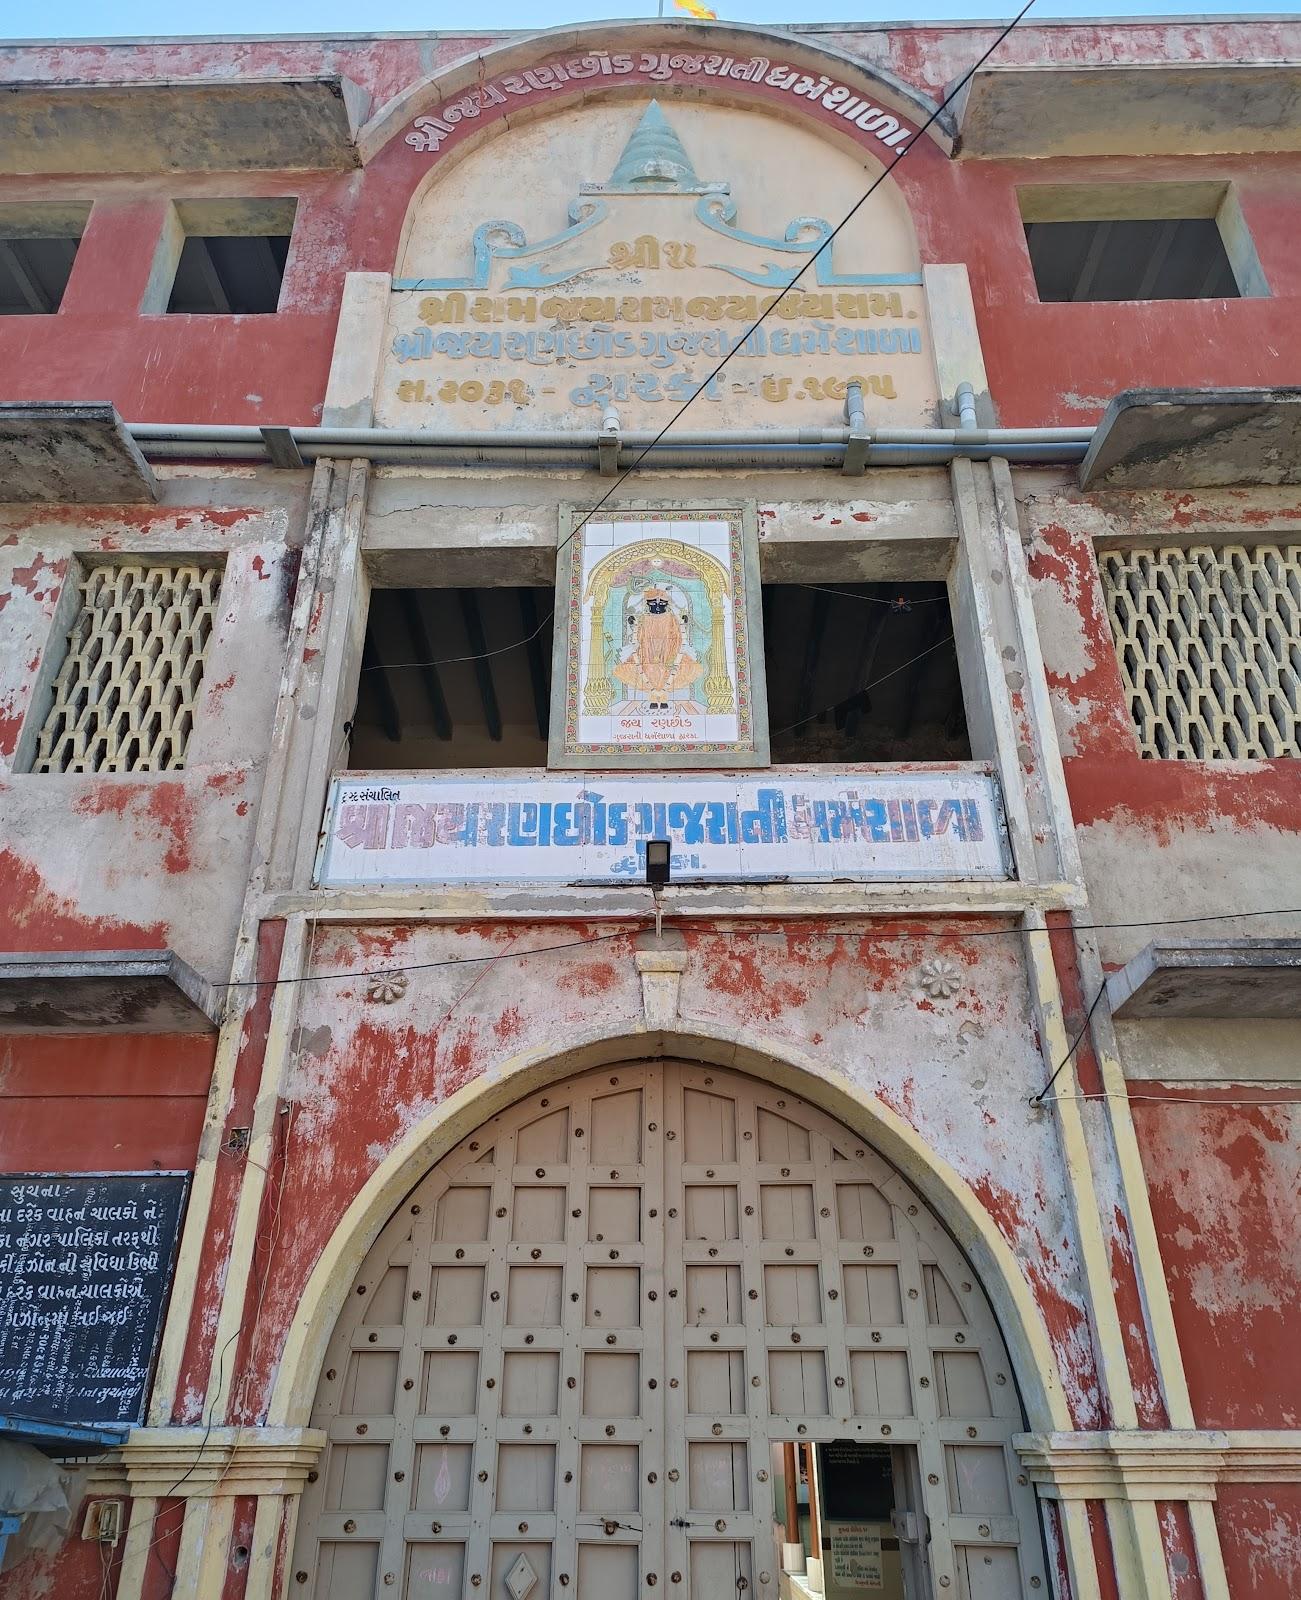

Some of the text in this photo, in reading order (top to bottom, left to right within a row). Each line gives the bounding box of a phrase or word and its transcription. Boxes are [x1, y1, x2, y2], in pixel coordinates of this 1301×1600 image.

[404, 115, 455, 152] શ્રી
[607, 235, 660, 270] શ્રી
[620, 719, 642, 728] જય
[359, 787, 401, 802] સંચાલિત
[16, 1202, 43, 1223] દરેક
[46, 1207, 86, 1225] વાહન
